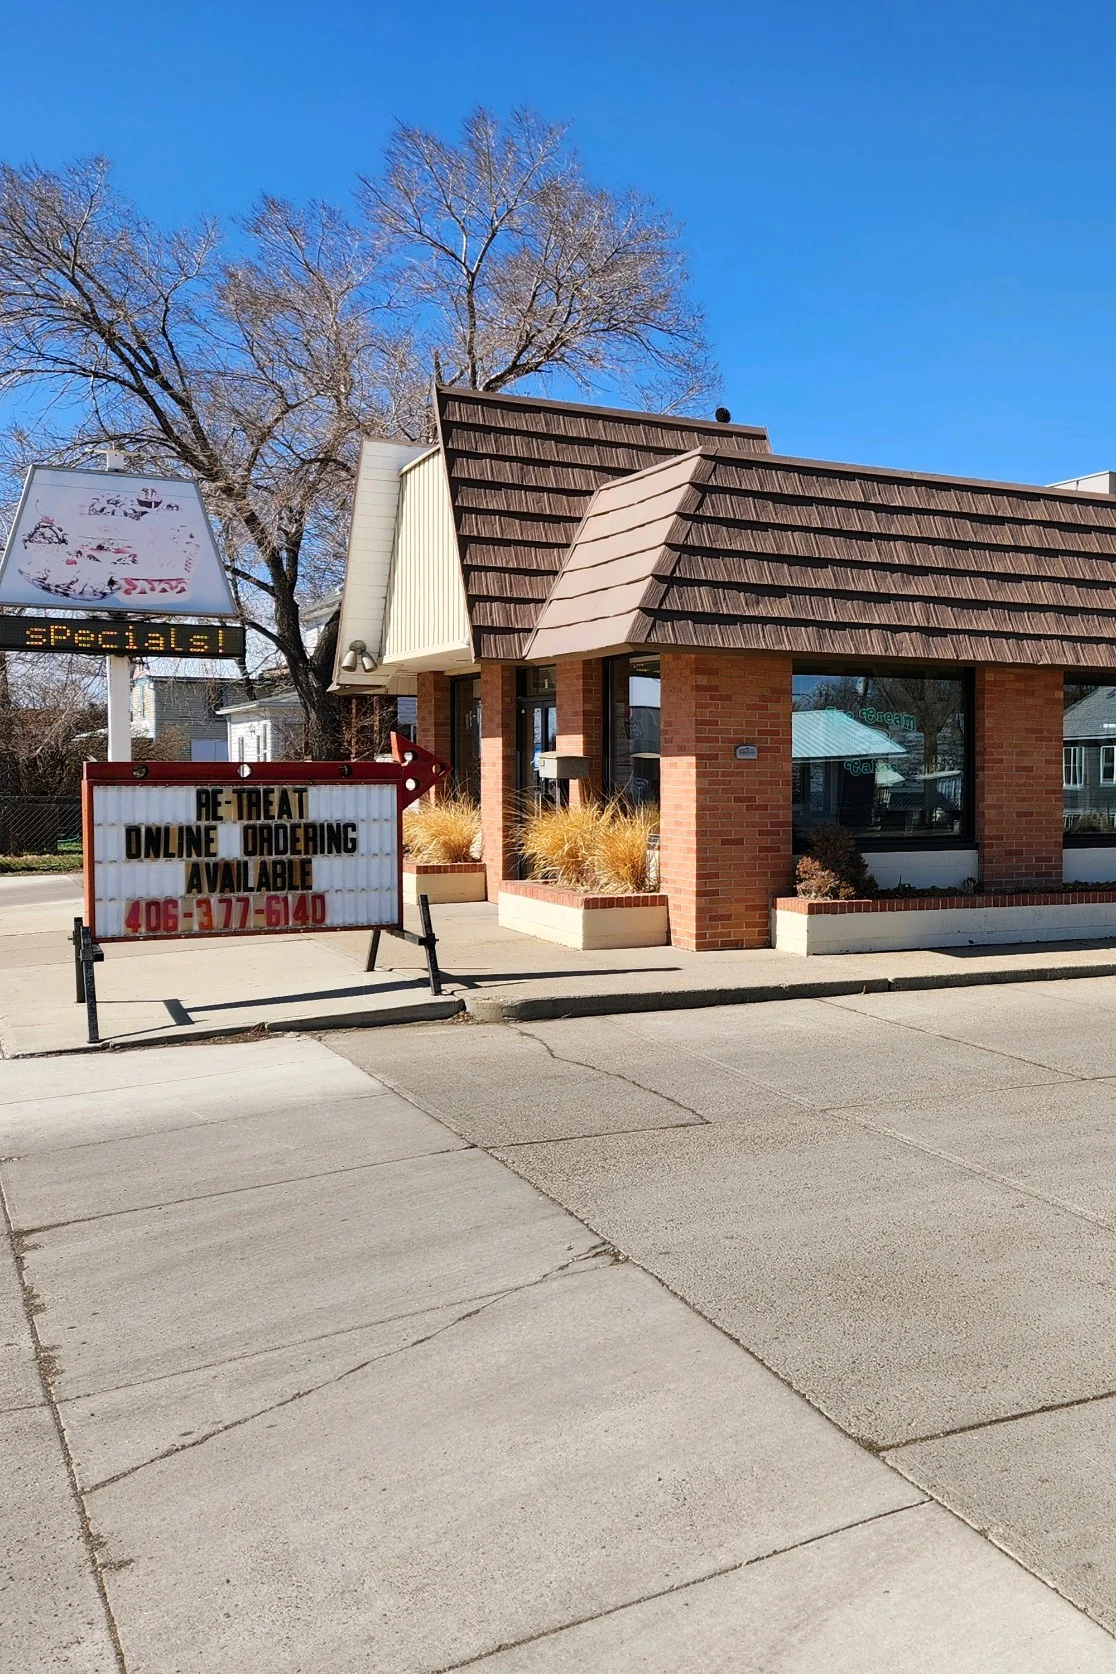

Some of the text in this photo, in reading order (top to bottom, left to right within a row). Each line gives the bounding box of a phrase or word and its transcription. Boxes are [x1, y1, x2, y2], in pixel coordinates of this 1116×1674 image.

[859, 707, 916, 732] Cream
[844, 758, 898, 777] Cakes
[196, 788, 307, 821] RE-TREAT
[125, 823, 357, 859] ONLINE ORDERING
[187, 858, 313, 894] AVAILABLE
[125, 894, 326, 932] 406-377-6140
